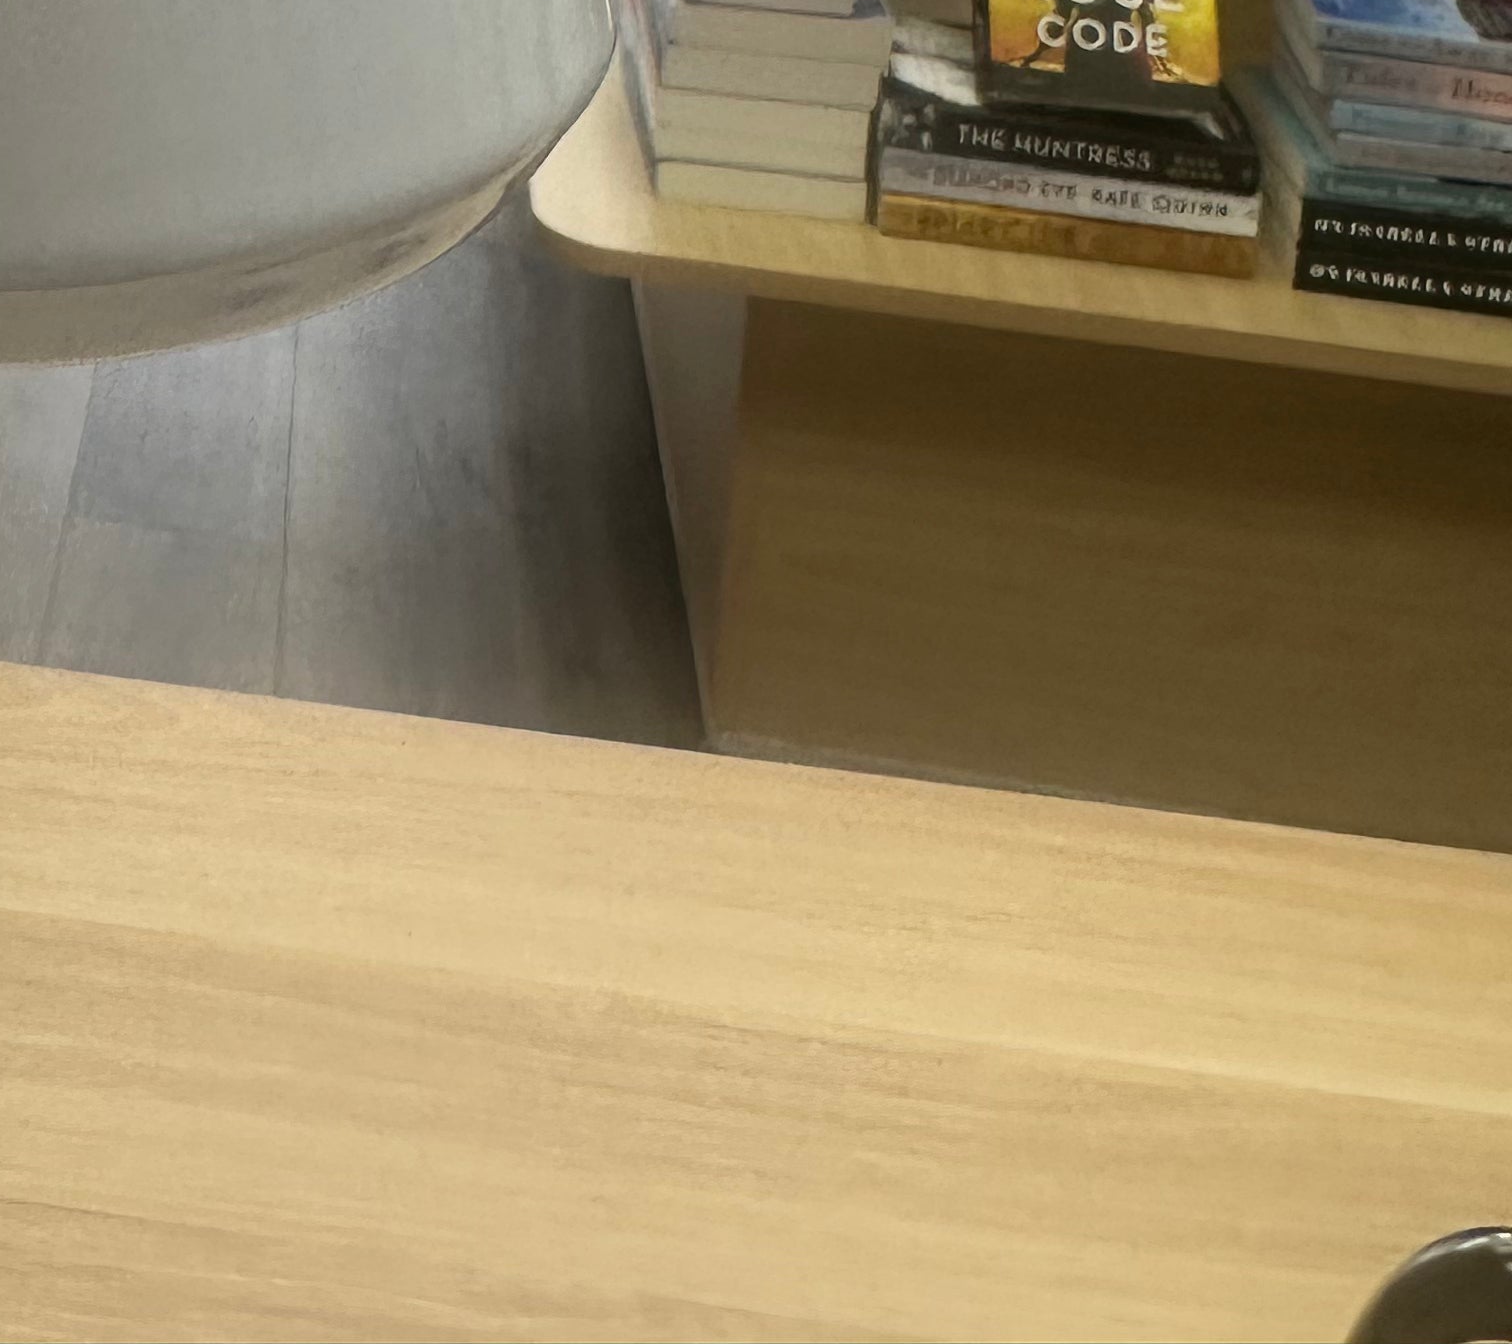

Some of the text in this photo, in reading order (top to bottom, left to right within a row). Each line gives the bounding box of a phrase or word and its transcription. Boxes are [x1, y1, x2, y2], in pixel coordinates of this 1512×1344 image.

[1036, 14, 1169, 59] CODE
[957, 122, 1006, 152] THE
[1014, 131, 1152, 170] HUNTRESS
